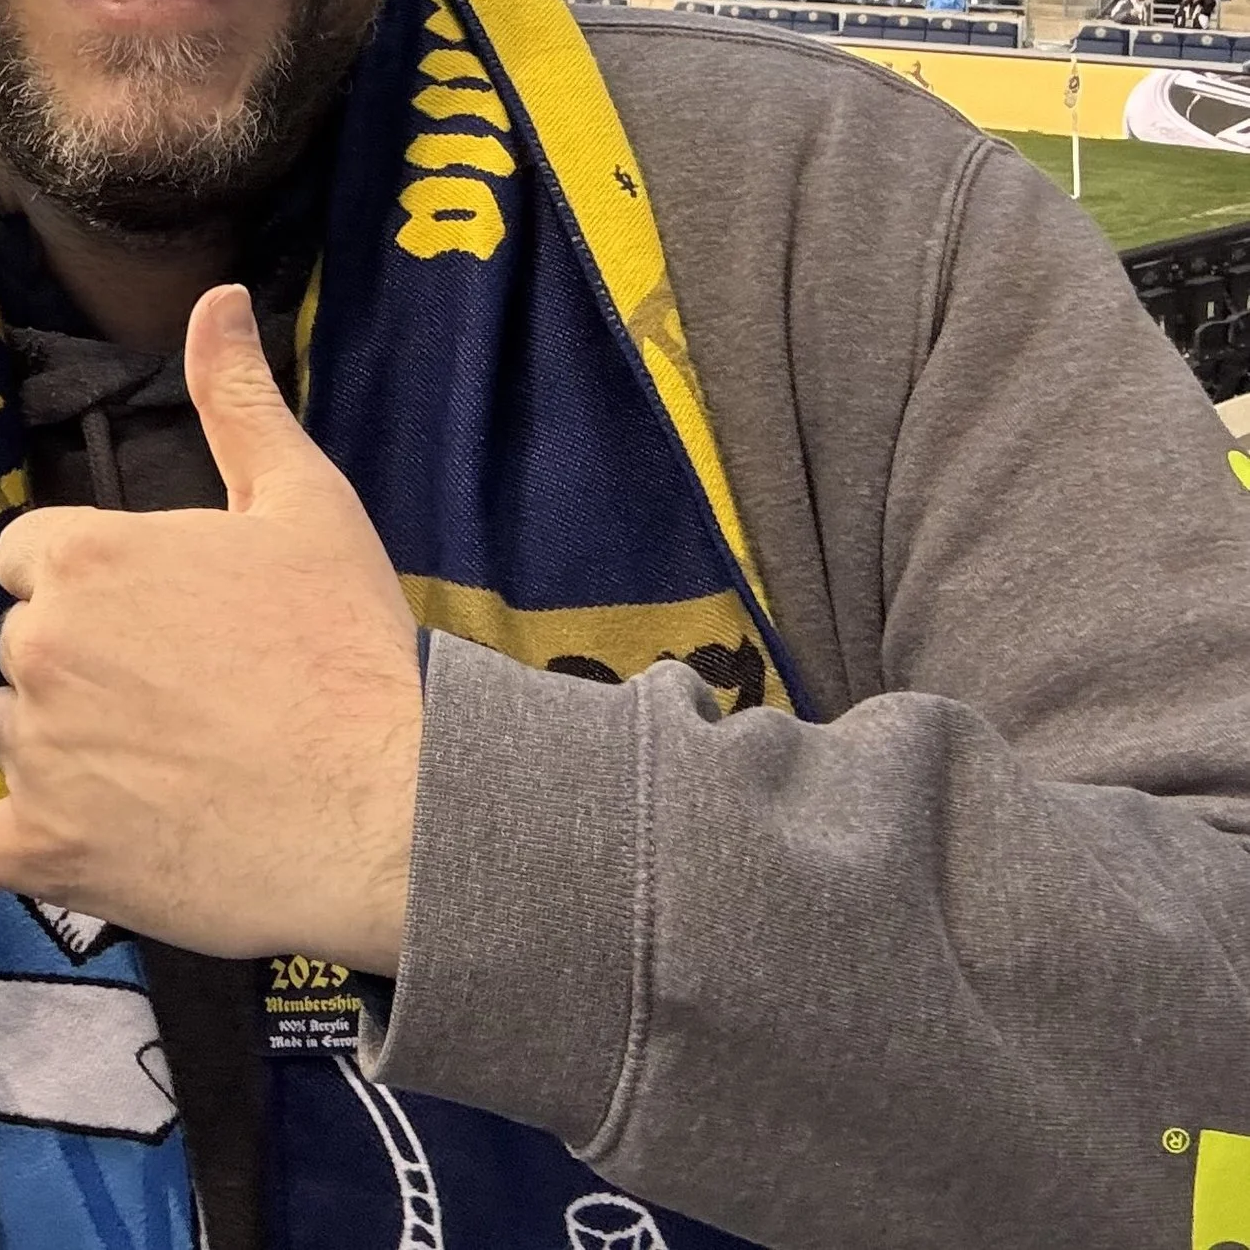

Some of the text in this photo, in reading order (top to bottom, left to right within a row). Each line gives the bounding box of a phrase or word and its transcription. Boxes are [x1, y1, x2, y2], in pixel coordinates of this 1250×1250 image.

[265, 994, 363, 1014] Membership
[309, 1017, 350, 1033] Acrylic
[269, 1035, 360, 1049] Made in Europ
